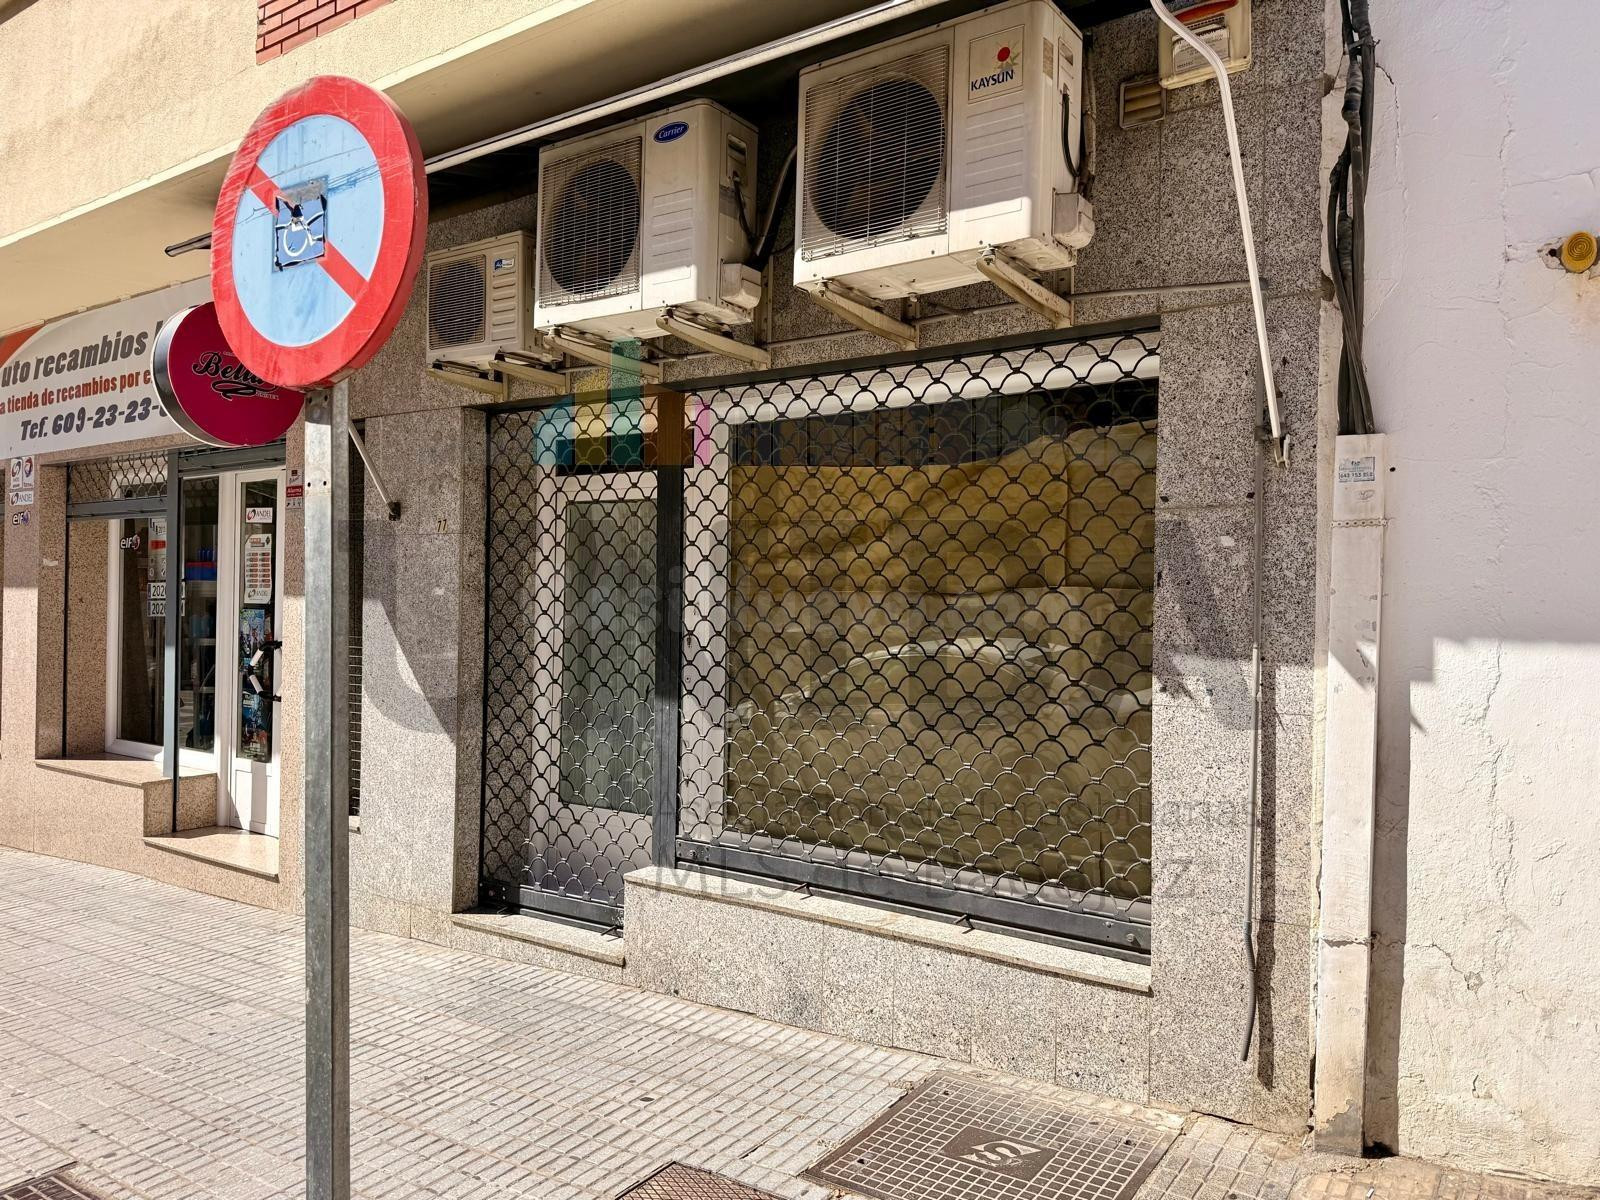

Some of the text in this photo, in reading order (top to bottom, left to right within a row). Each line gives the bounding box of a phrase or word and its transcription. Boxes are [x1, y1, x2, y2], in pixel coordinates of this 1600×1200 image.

[970, 69, 1015, 92] KAYSUN
[658, 125, 685, 139] Carrier
[33, 330, 149, 381] recambios
[7, 391, 39, 413] tienda
[41, 388, 54, 406] de
[56, 376, 118, 403] recambios
[119, 370, 140, 393] por
[120, 537, 133, 549] elf
